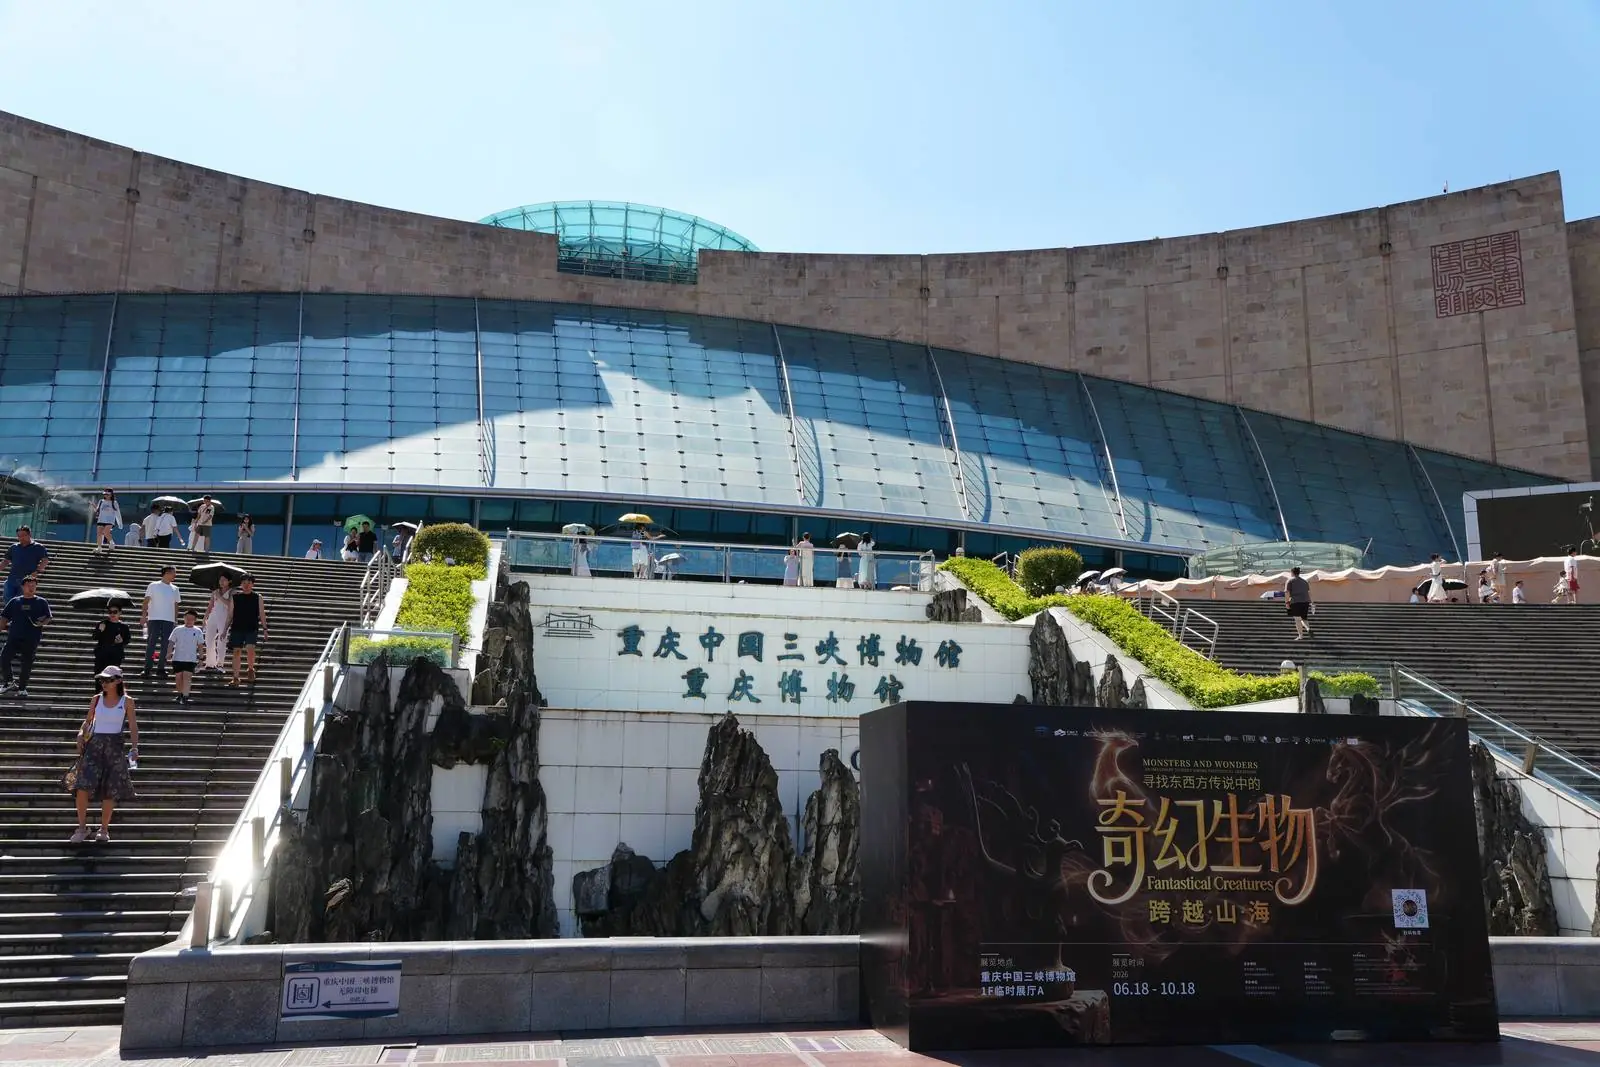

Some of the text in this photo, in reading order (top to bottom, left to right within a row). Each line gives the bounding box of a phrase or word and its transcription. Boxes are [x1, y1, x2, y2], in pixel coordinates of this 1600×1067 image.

[617, 625, 963, 669] 重庆中国三峡博物馆
[681, 667, 904, 704] 重庆博物馆
[1142, 759, 1258, 770] MONSTERS AND WONDERS
[1143, 774, 1261, 791] 寻找东西方传说中的
[1087, 791, 1317, 905] 奇幻生物
[1147, 876, 1273, 891] Fantastical Creatures
[980, 957, 1014, 968] 展览地点
[1112, 957, 1145, 968] 展览时间
[981, 970, 1076, 983] 重庆中国三峡博物馆
[982, 985, 1045, 997] 1F临时展厅A
[1113, 982, 1150, 996] 06.18
[1160, 981, 1196, 995] 10.18
